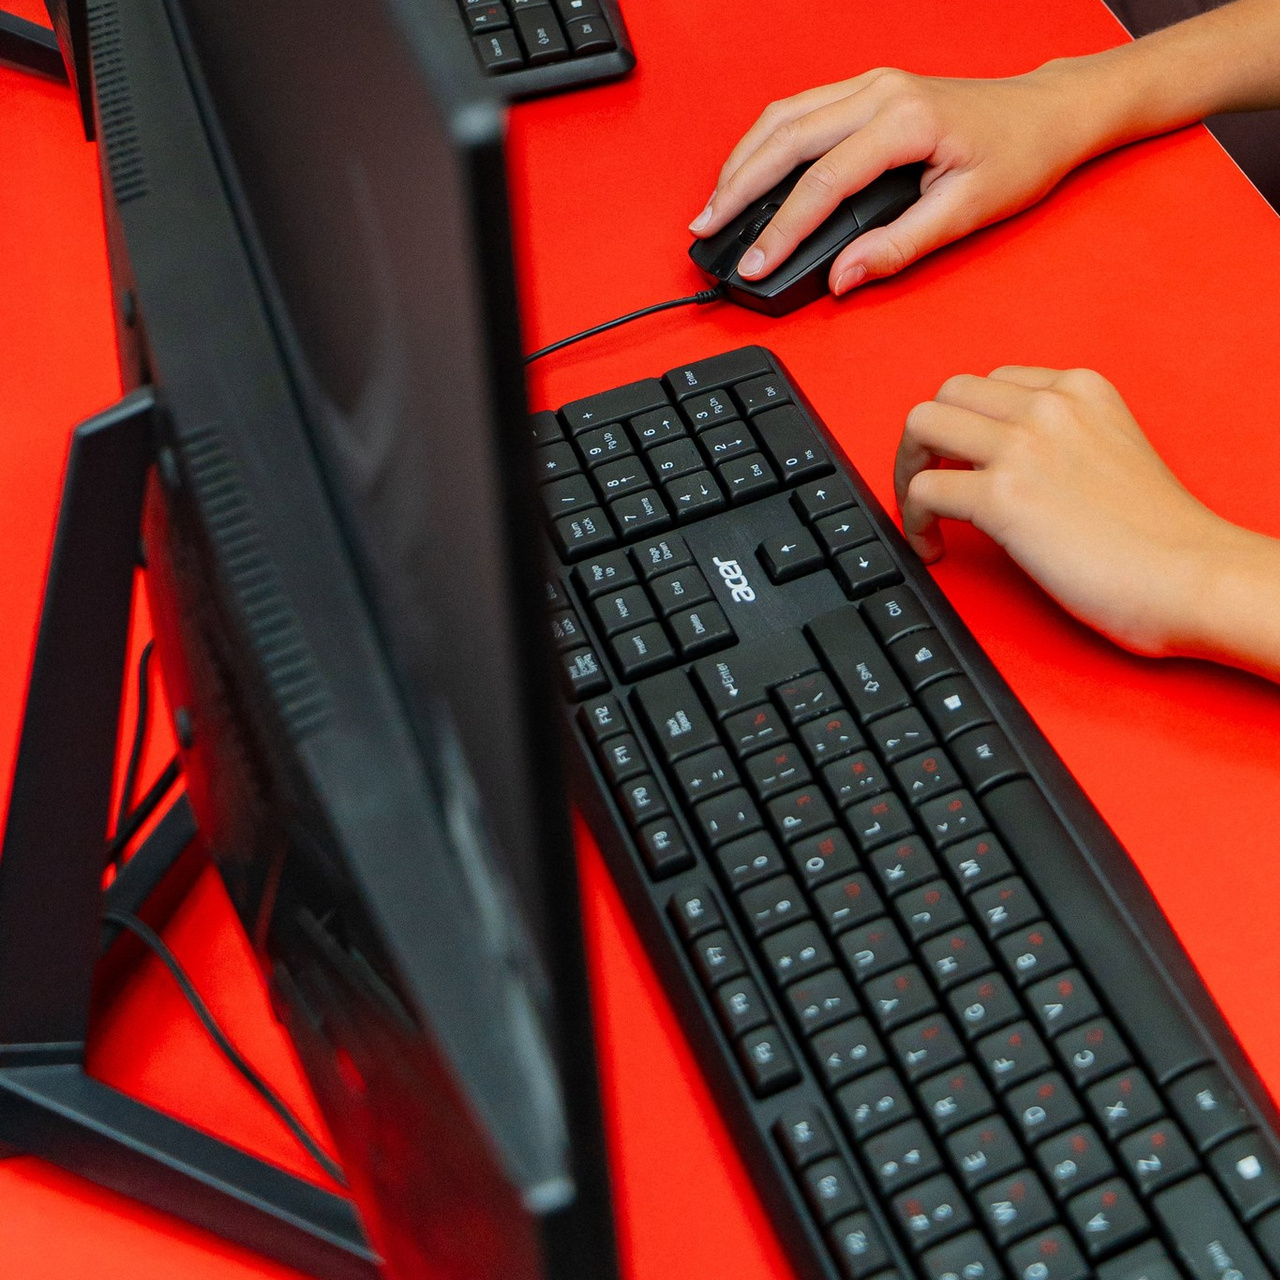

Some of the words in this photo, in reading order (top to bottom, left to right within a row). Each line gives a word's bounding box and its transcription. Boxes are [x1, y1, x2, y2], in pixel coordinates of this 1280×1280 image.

[475, 14, 488, 22] A
[684, 370, 698, 386] Enter
[696, 411, 708, 419] 3
[643, 428, 656, 437] 6
[589, 447, 602, 455] 9
[714, 443, 727, 451] 2
[661, 461, 674, 470] 5
[750, 464, 763, 477] End
[785, 458, 798, 466] 0
[607, 479, 620, 488] 8
[641, 497, 654, 516] Home
[680, 494, 692, 502] 4
[583, 516, 597, 534] Lock
[624, 514, 637, 522] 7
[571, 522, 583, 538] Num
[712, 556, 756, 603] acer
[885, 600, 902, 617] Ctrl
[716, 662, 734, 683] Enter
[595, 705, 613, 726] F12
[613, 745, 632, 766] F11
[783, 815, 802, 828] P
[864, 821, 881, 836] L
[806, 857, 825, 872] O
[885, 863, 906, 881] K
[958, 858, 981, 878] M
[911, 911, 932, 924] J
[987, 905, 1008, 924] N
[853, 949, 875, 968] U
[936, 955, 958, 975] H
[1016, 952, 1037, 970] B
[876, 998, 900, 1013] Y
[1042, 1003, 1065, 1021] V
[905, 1048, 928, 1065] T
[991, 1057, 1016, 1073] F
[1073, 1049, 1096, 1069] C
[933, 1096, 958, 1117] R
[1104, 1100, 1129, 1121] X
[1022, 1105, 1047, 1126] D
[962, 1150, 987, 1172] E
[1136, 1153, 1162, 1175] Z
[1084, 1211, 1111, 1233] A
